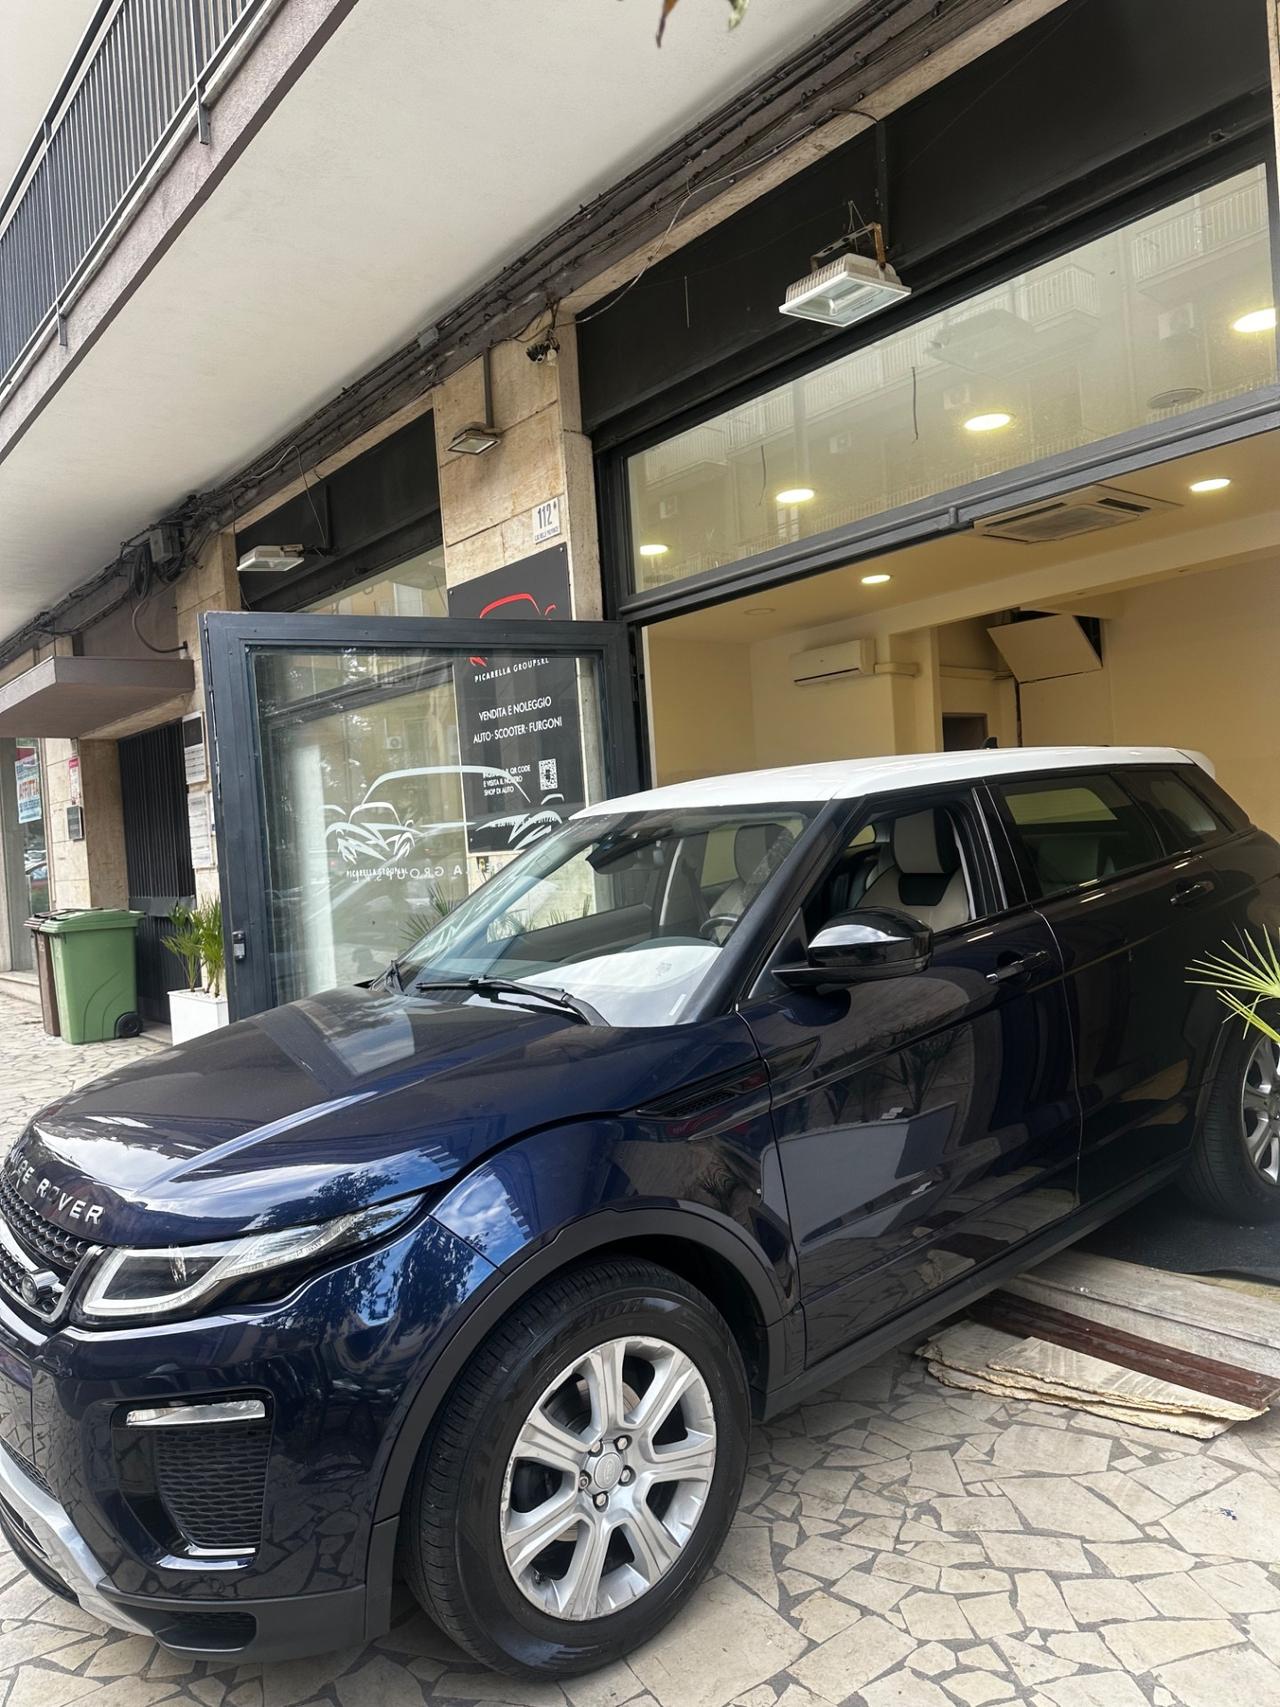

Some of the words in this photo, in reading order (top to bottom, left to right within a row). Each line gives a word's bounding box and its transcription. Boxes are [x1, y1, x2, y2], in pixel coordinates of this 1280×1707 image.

[537, 503, 553, 529] 112
[474, 666, 511, 683] PICARELLA
[513, 659, 537, 673] GROUP
[478, 706, 507, 722] VENDITA
[507, 705, 513, 716] E
[513, 696, 552, 715] NOLEGGIO
[528, 716, 563, 733] FURGONI
[517, 764, 531, 773] CODE
[36, 1178, 105, 1225] ROVER
